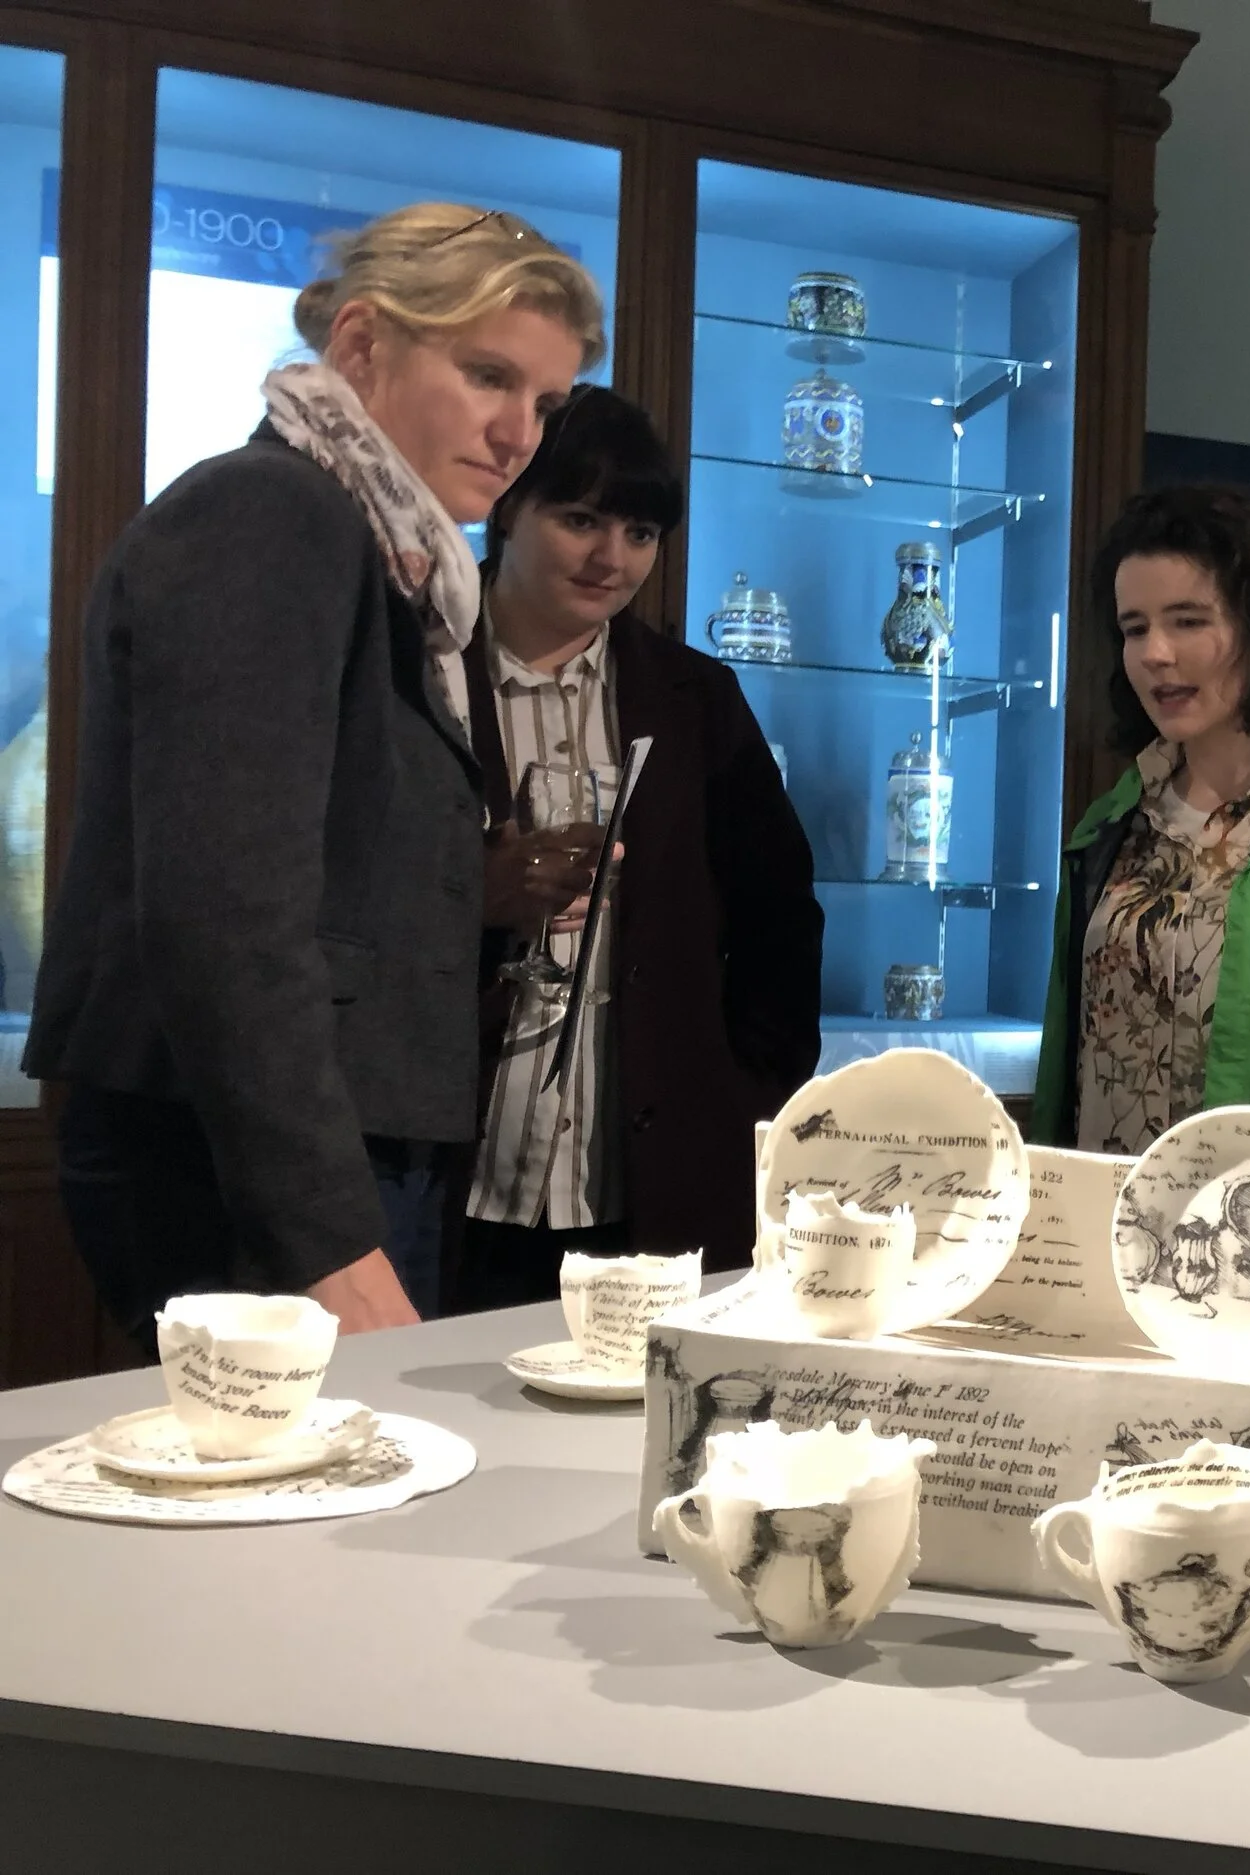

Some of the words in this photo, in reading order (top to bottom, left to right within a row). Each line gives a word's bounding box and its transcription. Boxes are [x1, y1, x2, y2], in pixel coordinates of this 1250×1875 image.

[917, 1135, 987, 1148] EXHIBITION
[793, 1269, 876, 1299] Bowes
[241, 1368, 283, 1382] room
[955, 1386, 991, 1403] 1892
[877, 1399, 893, 1415] in
[896, 1402, 920, 1418] the
[922, 1403, 980, 1424] interest
[982, 1410, 1002, 1430] of
[1003, 1412, 1026, 1430] the
[956, 1433, 967, 1444] a
[969, 1430, 1025, 1451] fervent
[1028, 1437, 1063, 1459] hope
[979, 1452, 997, 1470] be
[999, 1461, 1034, 1477] open
[1037, 1464, 1058, 1478] on
[980, 1479, 1013, 1494] man
[1016, 1484, 1059, 1500] could
[932, 1492, 990, 1513] without
